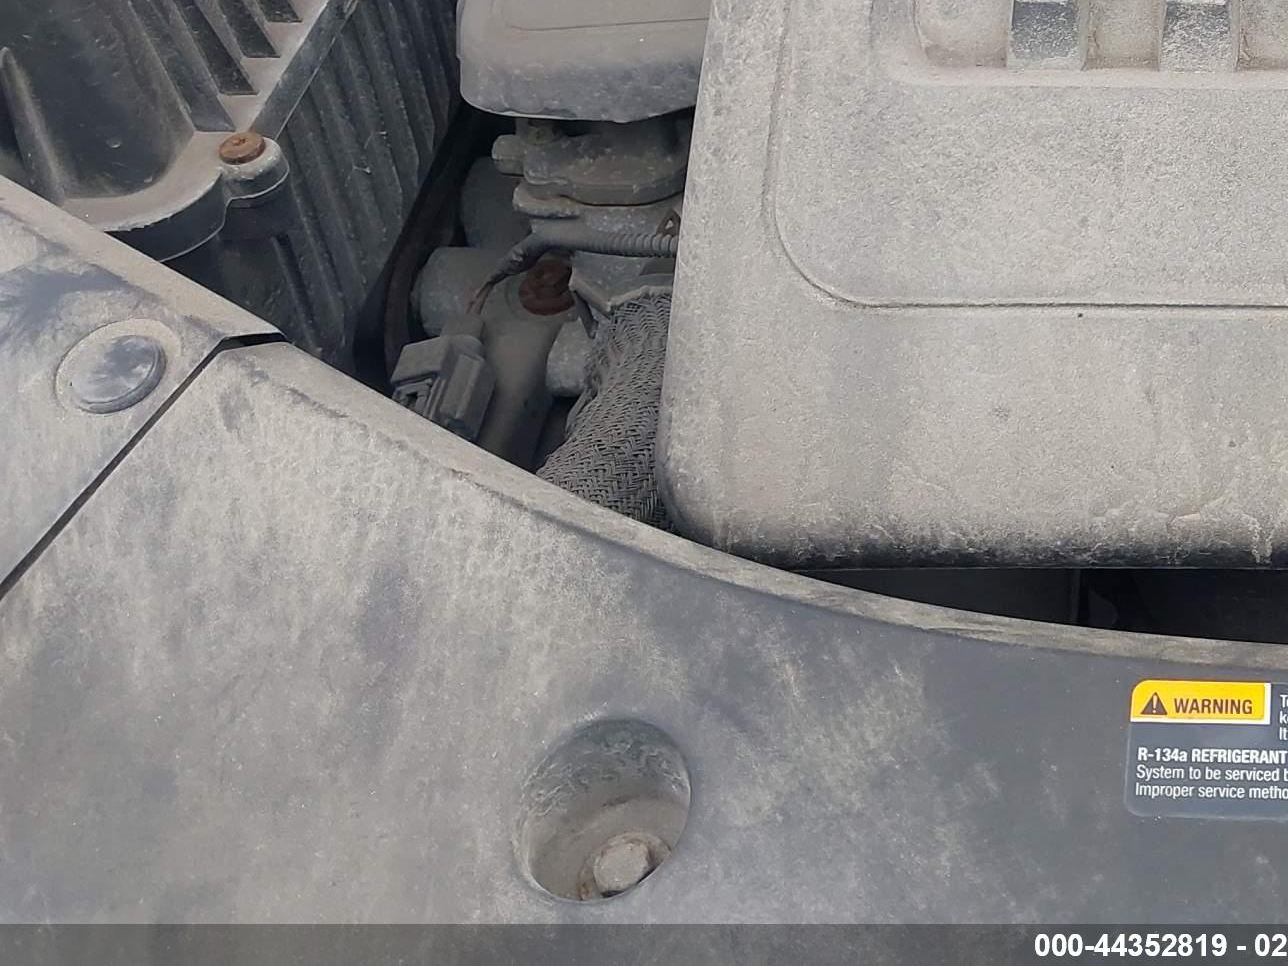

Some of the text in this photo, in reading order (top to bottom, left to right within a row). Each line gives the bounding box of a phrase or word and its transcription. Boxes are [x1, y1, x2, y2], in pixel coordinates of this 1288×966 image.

[1174, 698, 1253, 714] WARNING
[1279, 727, 1287, 740] It
[1138, 748, 1187, 761] R-134a
[1192, 748, 1288, 764] REFRIGERANT
[1136, 765, 1184, 780] System
[1189, 768, 1201, 779] to
[1205, 768, 1221, 780] be
[1225, 768, 1279, 781] serviced
[1135, 783, 1194, 798] Improper
[1198, 786, 1244, 798] service
